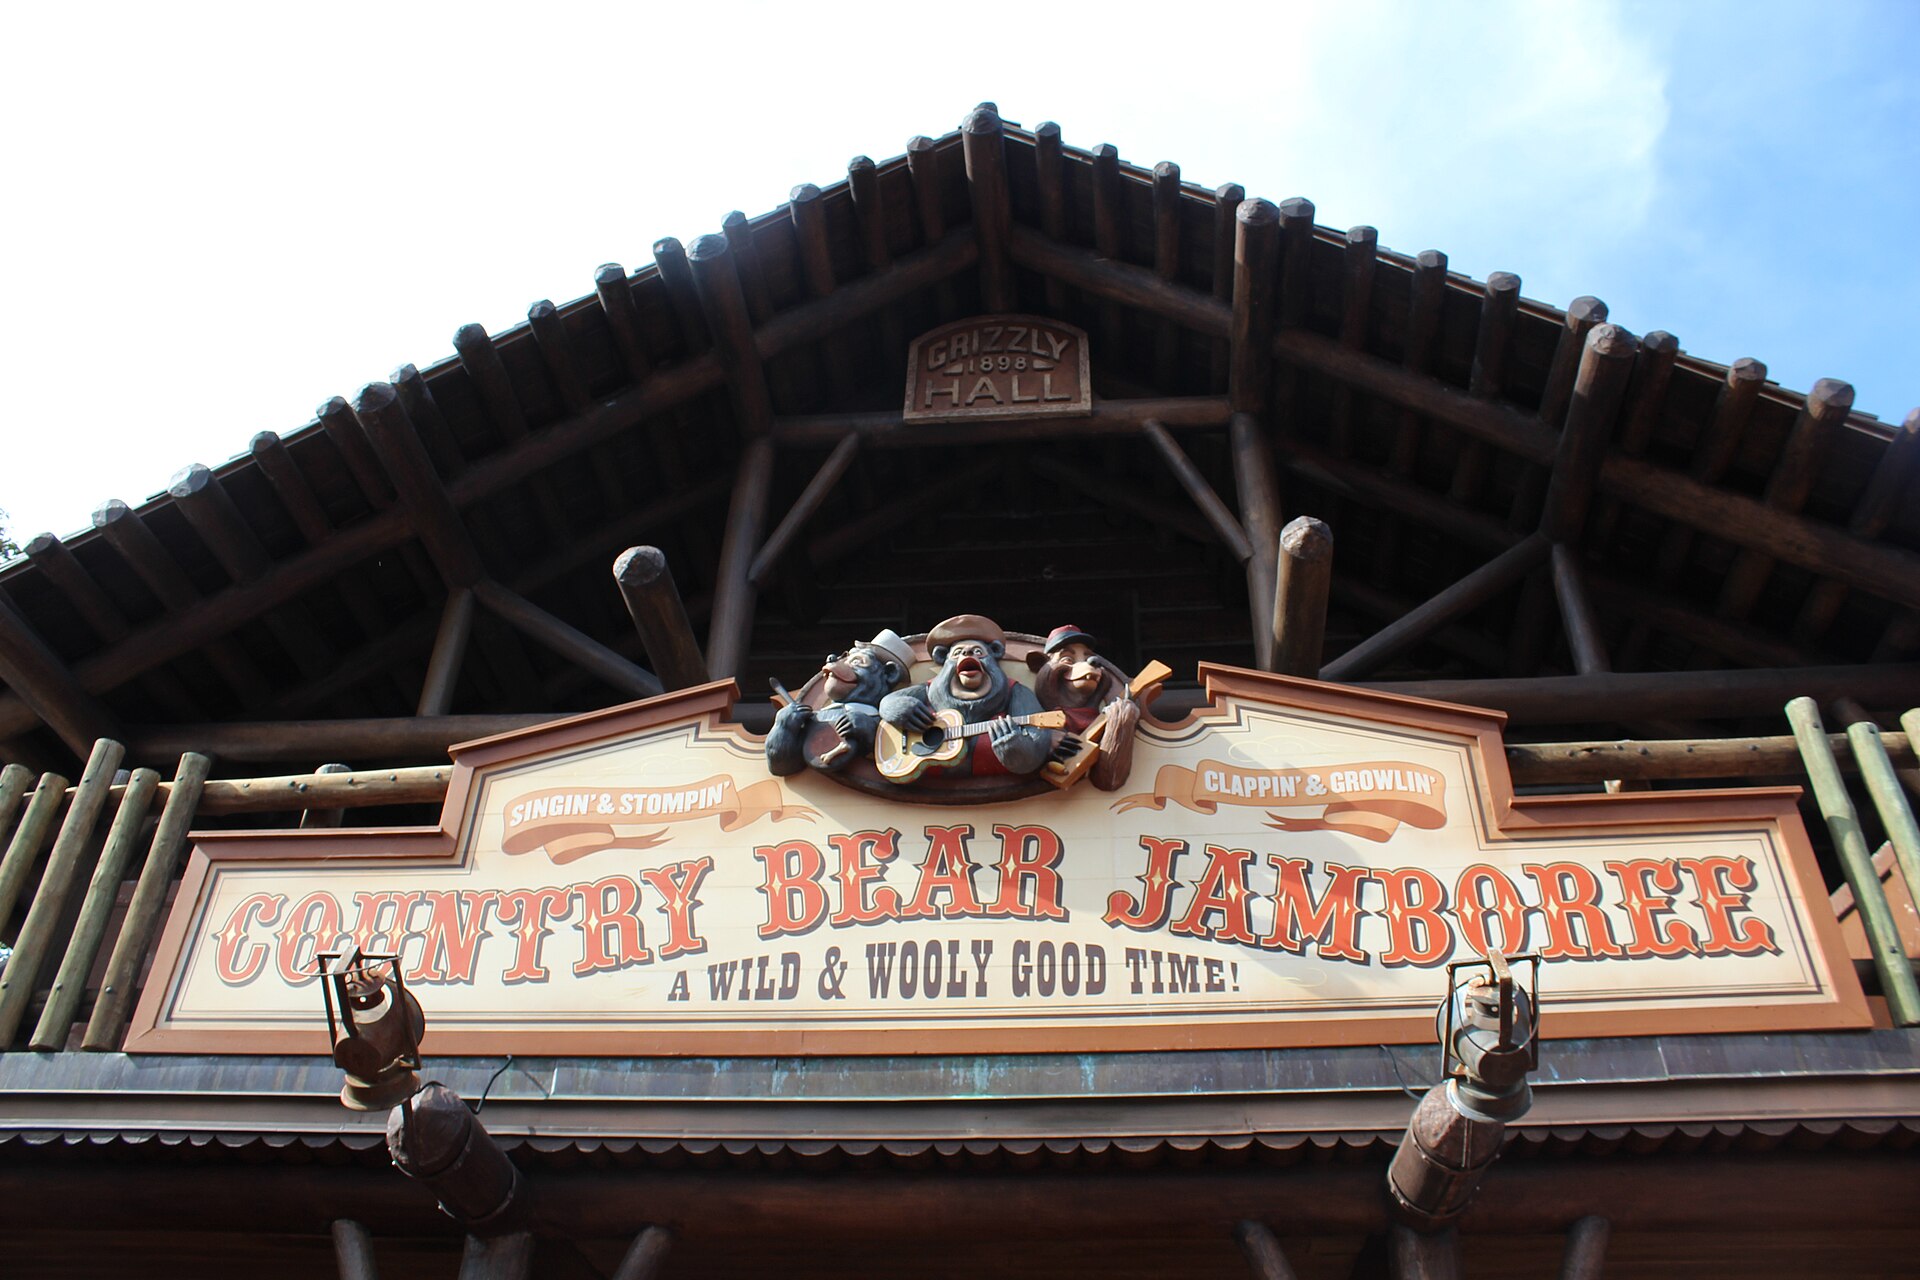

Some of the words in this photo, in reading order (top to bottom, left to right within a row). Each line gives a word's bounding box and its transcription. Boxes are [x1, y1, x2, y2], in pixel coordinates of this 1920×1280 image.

[927, 326, 1069, 371] GRIZZLY
[968, 356, 1026, 373] 1898
[925, 373, 1072, 408] HALL
[510, 793, 595, 827] SINGIN'
[596, 793, 614, 815] &
[619, 780, 731, 815] STOMPIN'
[1204, 770, 1301, 797] CLAPPIN'
[1305, 774, 1328, 796] &
[1330, 769, 1436, 795] GROWLIN'
[210, 856, 715, 987] COUNTRY
[752, 823, 1070, 941] BEAR
[1101, 834, 1784, 968] JAMBOREE
[668, 970, 690, 1000] A
[707, 951, 800, 1000] WILD
[817, 946, 848, 999] &
[865, 939, 993, 999] WOOLY
[1012, 939, 1106, 997] GOOD
[1125, 946, 1241, 995] TIME!
